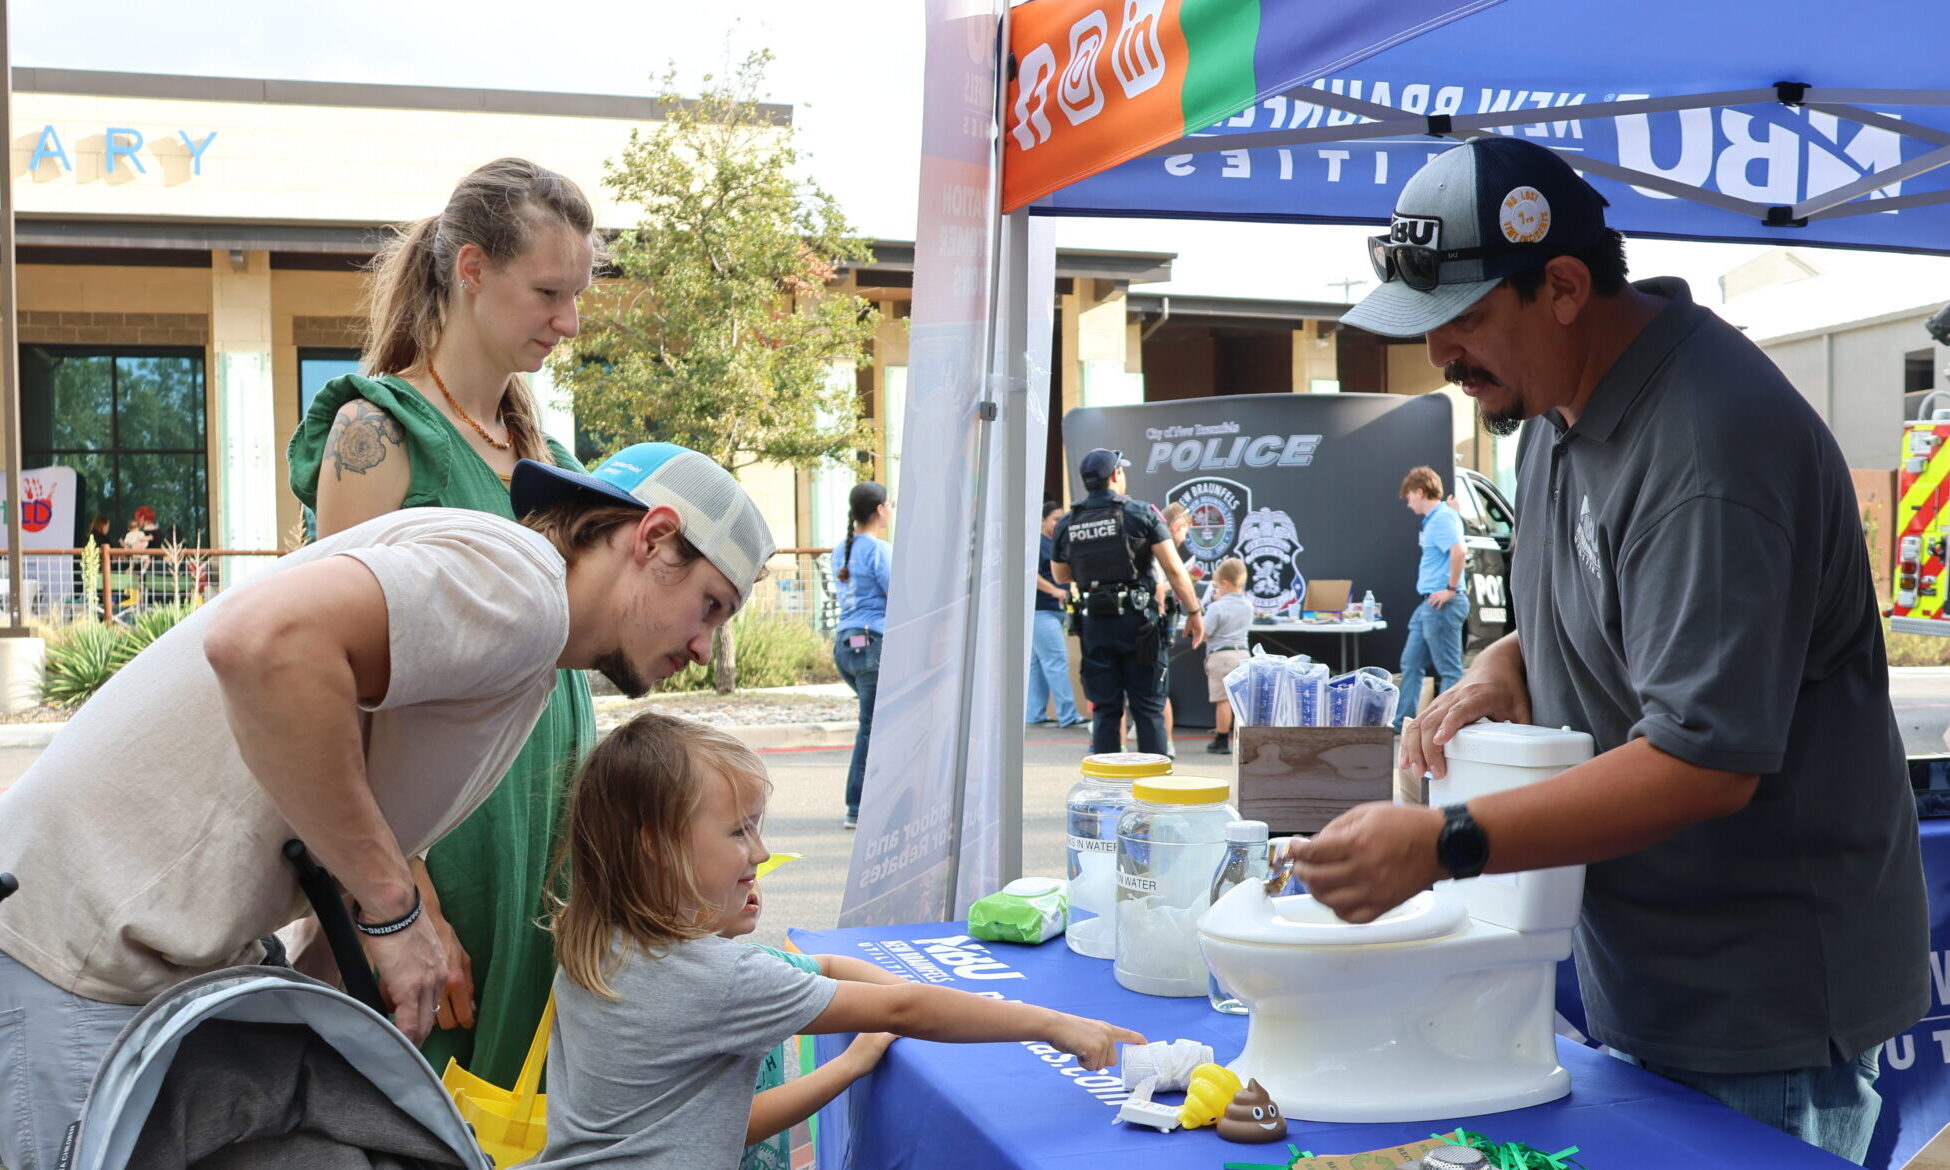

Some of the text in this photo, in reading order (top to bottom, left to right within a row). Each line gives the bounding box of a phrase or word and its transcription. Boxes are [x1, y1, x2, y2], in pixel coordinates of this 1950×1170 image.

[1145, 435, 1322, 473] POLICE
[1178, 483, 1241, 510] EW BRAUNFELS
[1069, 525, 1117, 542] POLICE
[1076, 839, 1084, 848] IN
[1125, 875, 1157, 890] WATER
